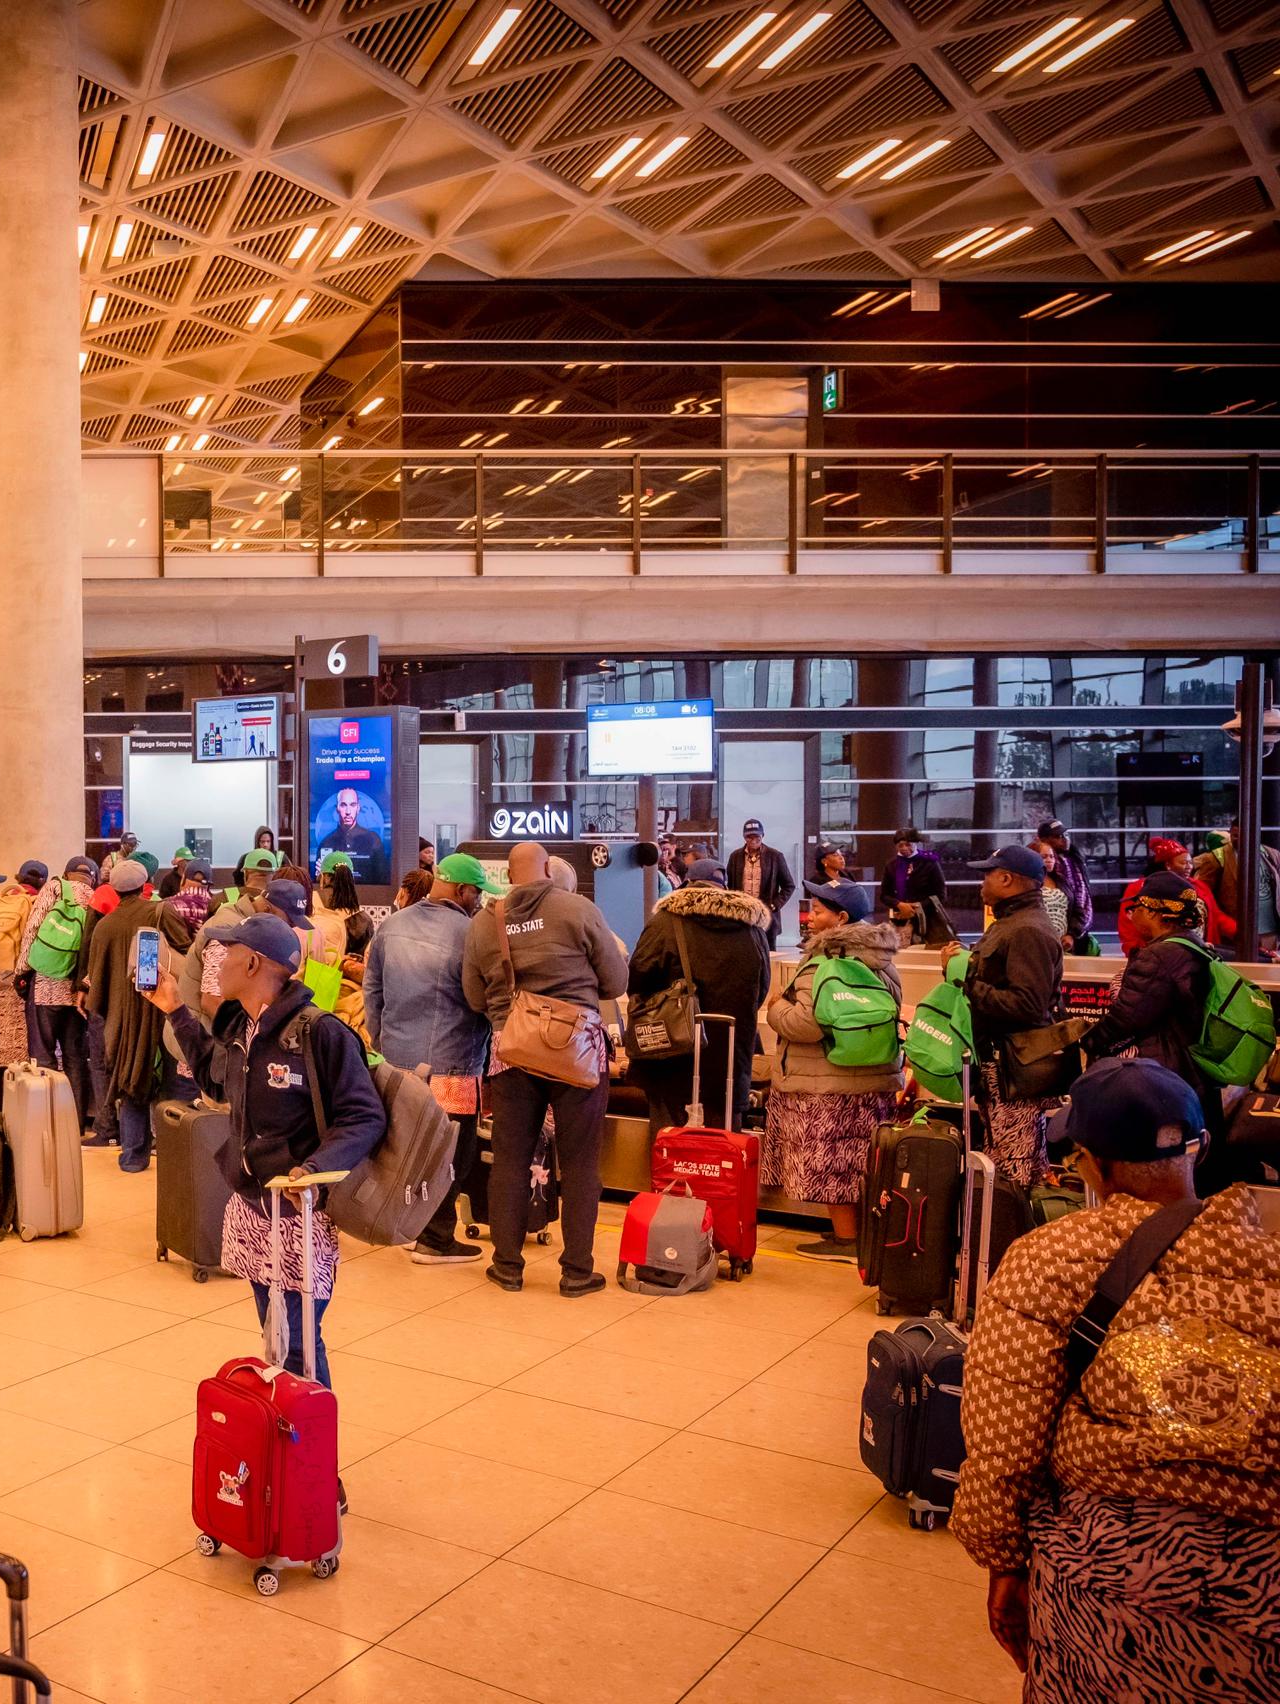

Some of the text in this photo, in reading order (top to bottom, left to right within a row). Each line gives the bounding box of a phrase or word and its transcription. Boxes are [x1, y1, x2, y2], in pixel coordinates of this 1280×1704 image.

[327, 640, 347, 675] 6
[634, 705, 656, 714] 08:08
[691, 704, 698, 714] 6
[343, 728, 357, 737] CFI
[131, 741, 155, 749] Baggage
[353, 755, 385, 764] Champion
[511, 804, 568, 835] zain
[521, 918, 545, 932] STATE
[1065, 1006, 1102, 1015] versized
[699, 1163, 720, 1172] STATE
[673, 1167, 720, 1178] MEDICAL TEAM
